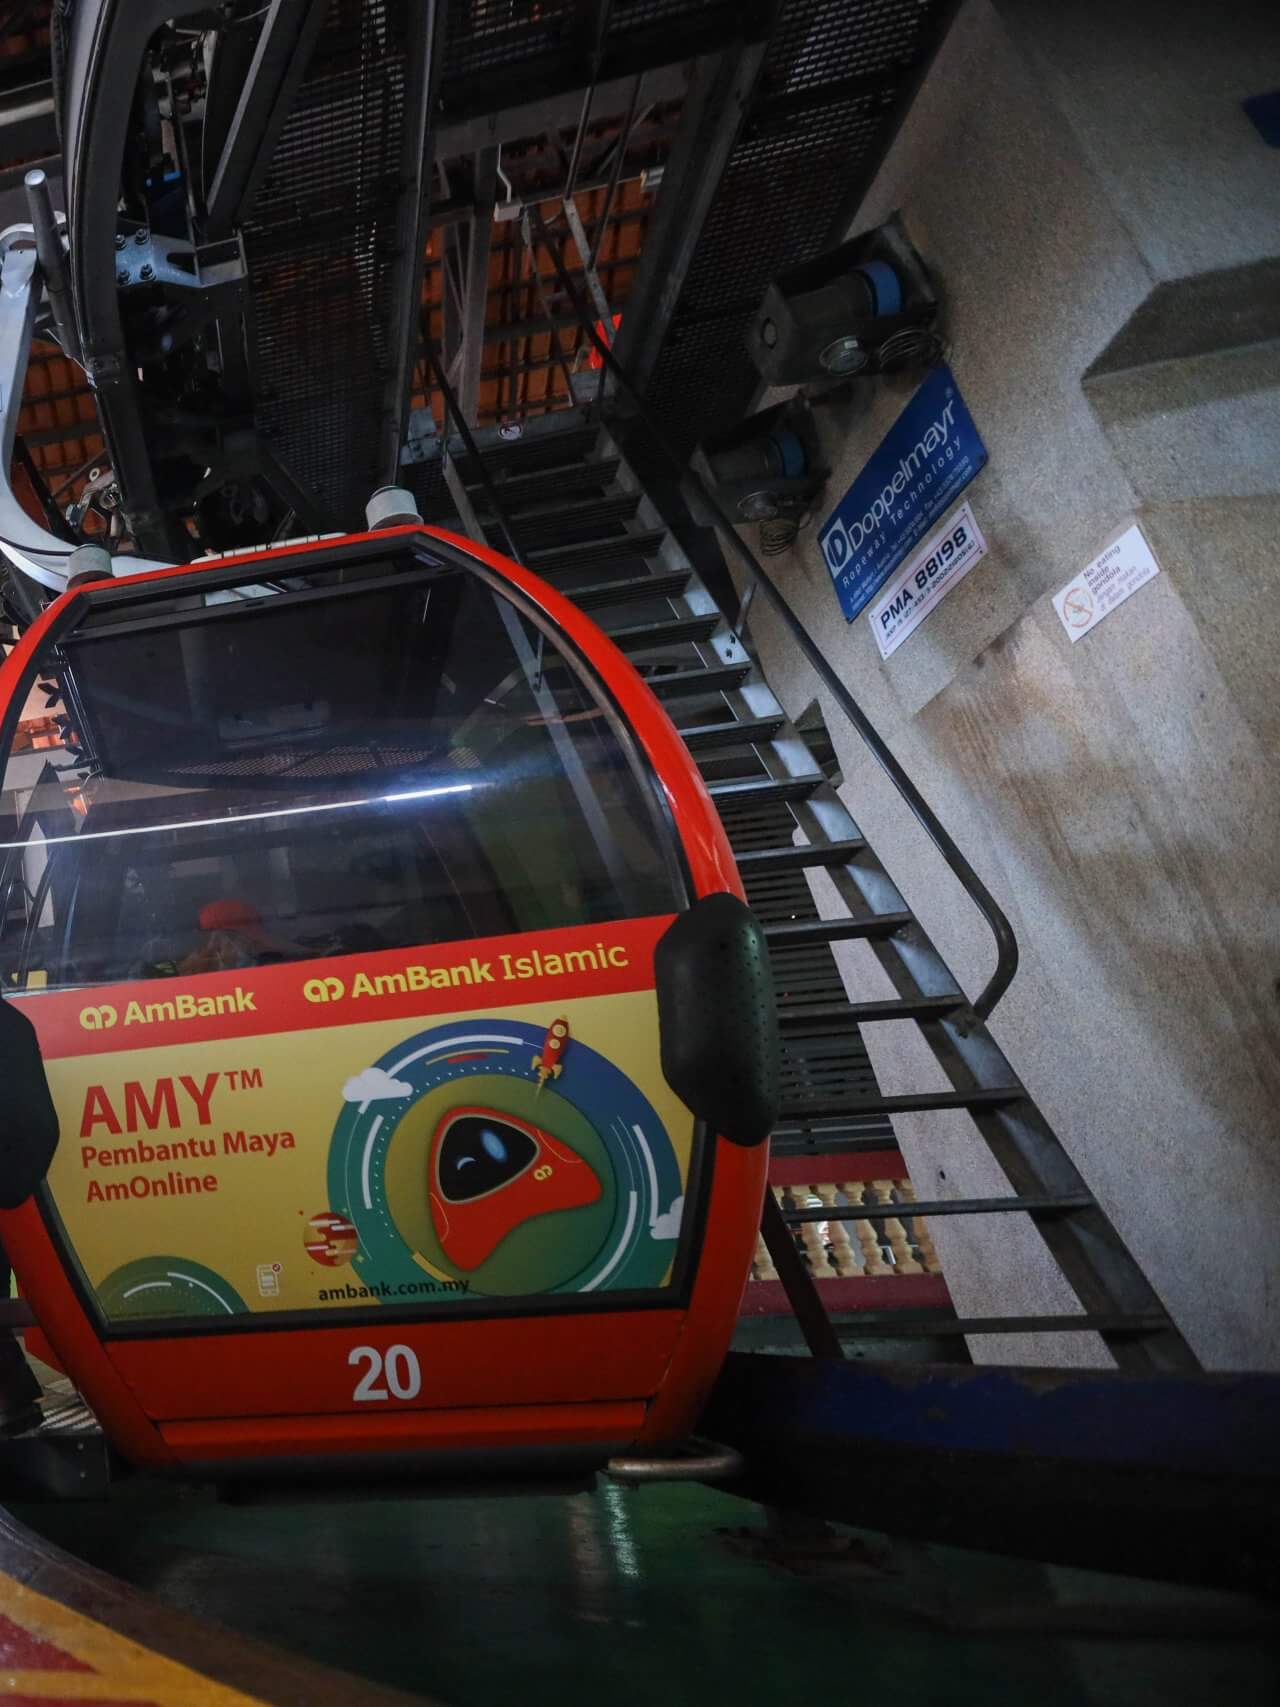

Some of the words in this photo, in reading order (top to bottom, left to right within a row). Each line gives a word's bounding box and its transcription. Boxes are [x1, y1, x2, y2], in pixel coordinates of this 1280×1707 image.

[847, 400, 955, 551] Doppelmayr
[842, 532, 887, 588] Ropeway
[889, 435, 962, 527] Technology
[880, 588, 914, 629] PMA
[914, 526, 968, 590] 88198
[1083, 568, 1095, 579] No
[1096, 545, 1120, 568] eating
[1087, 566, 1110, 588] inside
[1090, 566, 1121, 595] gondola
[351, 957, 495, 998] AmBank
[498, 943, 629, 981] Islamic
[124, 986, 256, 1026] AmBank
[81, 1137, 217, 1169] Pembantu
[223, 1130, 297, 1158] Maya
[87, 1171, 219, 1204] AmOnline
[318, 1279, 470, 1301] ambank.com.my
[348, 1344, 422, 1402] 20
